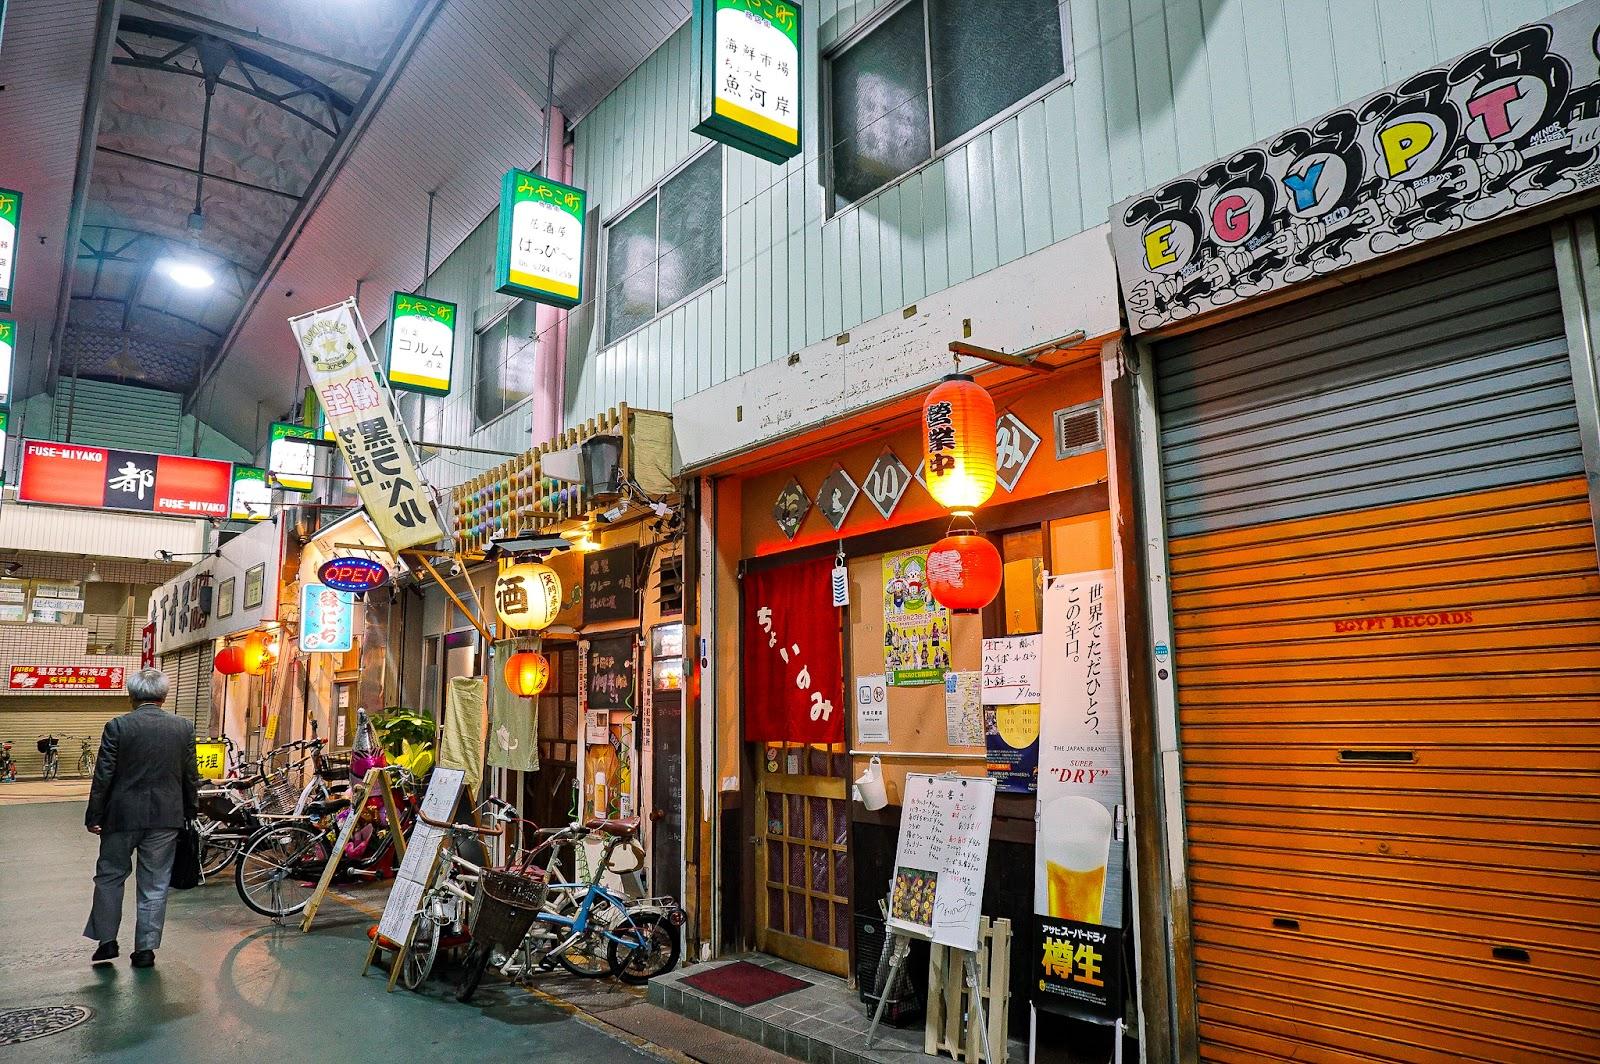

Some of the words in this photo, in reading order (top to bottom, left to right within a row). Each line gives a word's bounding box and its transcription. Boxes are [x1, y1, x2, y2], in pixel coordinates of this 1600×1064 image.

[725, 58, 761, 82] ちょっと
[726, 37, 789, 77] 海鮮市場
[724, 74, 790, 116] 魚河岸
[1530, 121, 1561, 143] MINOR
[517, 178, 581, 213] みやこ町
[397, 298, 451, 321] みやこ町
[399, 339, 444, 358] コルム
[28, 446, 103, 463] FUSE-MIYAKO
[926, 400, 956, 477] 営業中
[108, 461, 154, 500] 都
[159, 498, 226, 513] FUSE-MIYAKO
[325, 567, 383, 583] OPEN
[496, 575, 529, 615] 酒
[1065, 586, 1081, 662] この辛口。
[1334, 617, 1386, 633] EGYPT
[1392, 611, 1473, 629] RECORDS
[757, 607, 833, 721] ちょいのみ
[1085, 583, 1104, 736] 世界でただひとつ、
[1042, 924, 1107, 944] アサヒスーパードライ
[1041, 937, 1104, 987] 樽生
